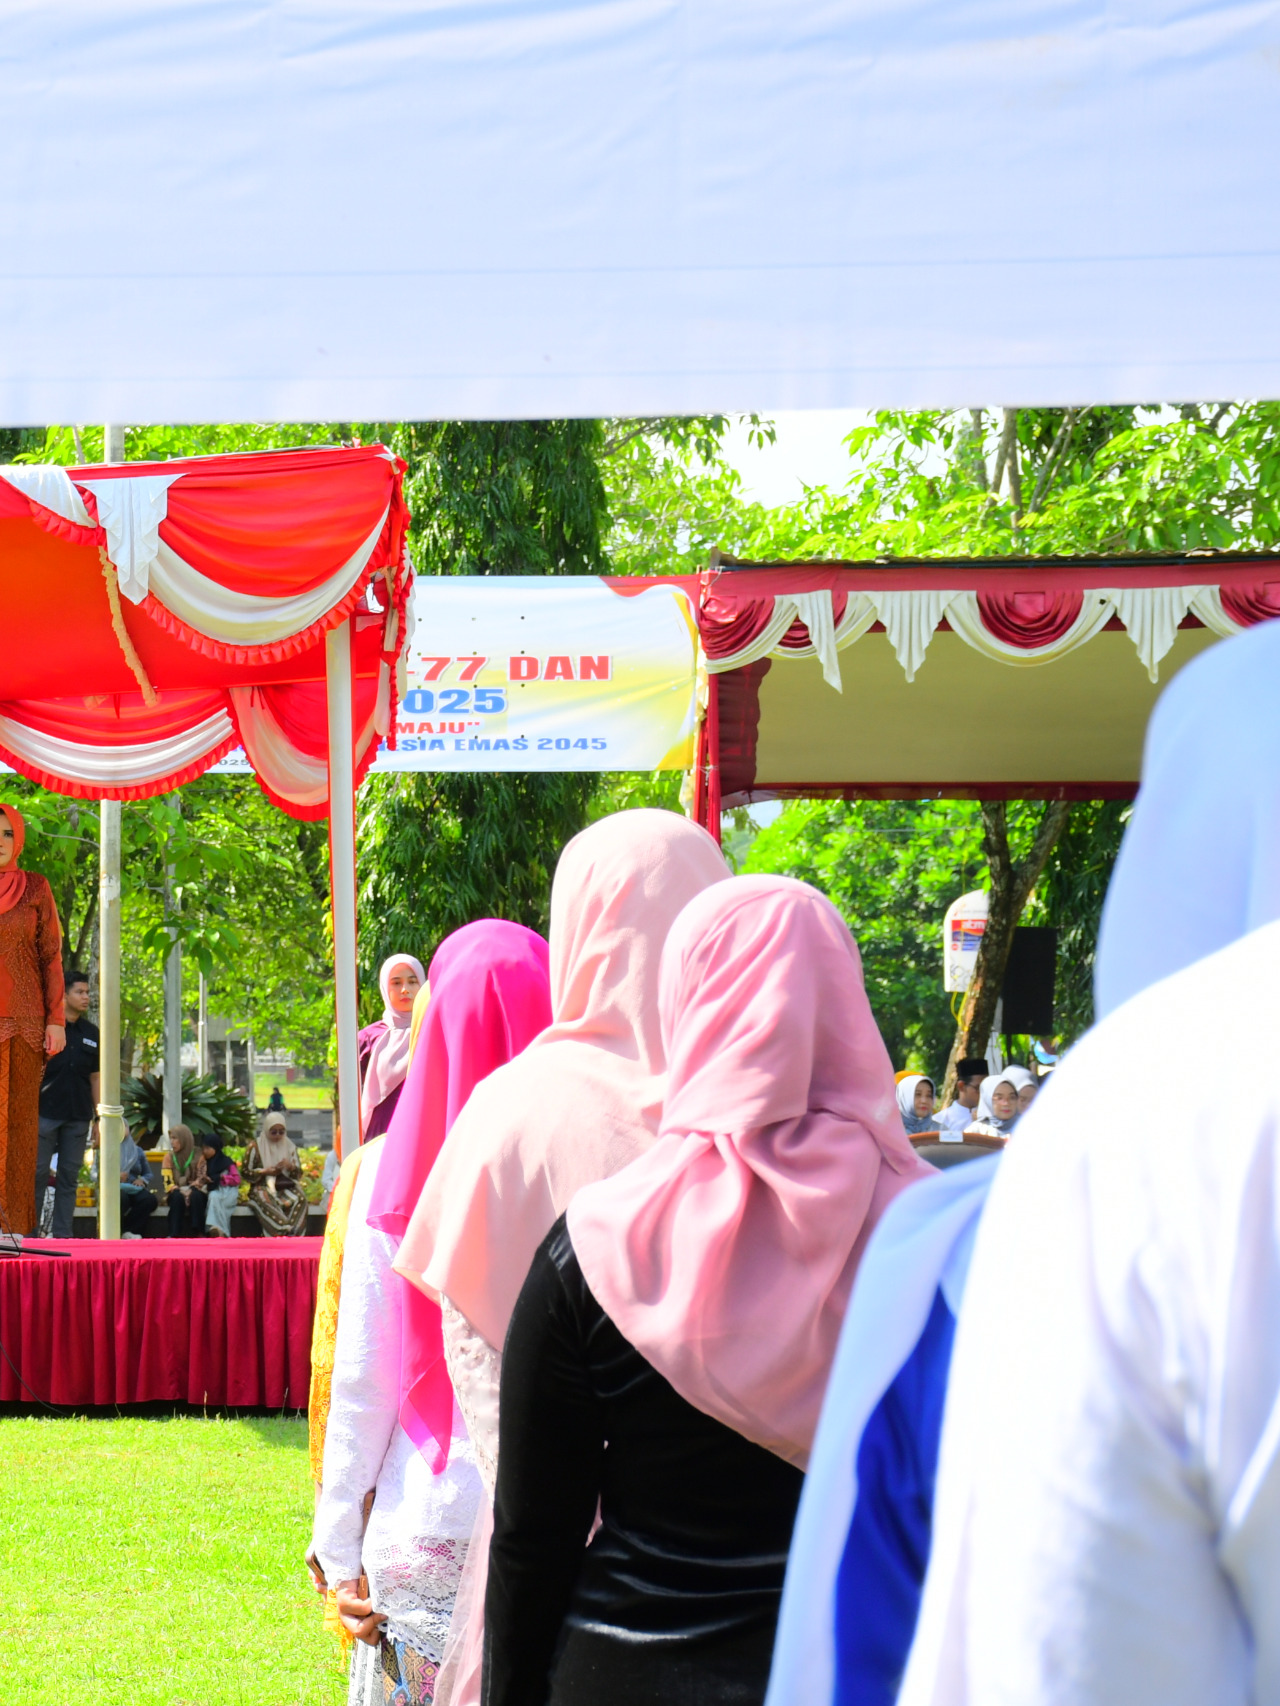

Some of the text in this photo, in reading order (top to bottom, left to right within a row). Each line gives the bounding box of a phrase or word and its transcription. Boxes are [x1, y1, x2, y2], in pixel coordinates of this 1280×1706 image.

[509, 655, 610, 681] DAN
[402, 688, 506, 714] 025
[454, 738, 529, 751] EMAS
[537, 737, 608, 750] 2045
